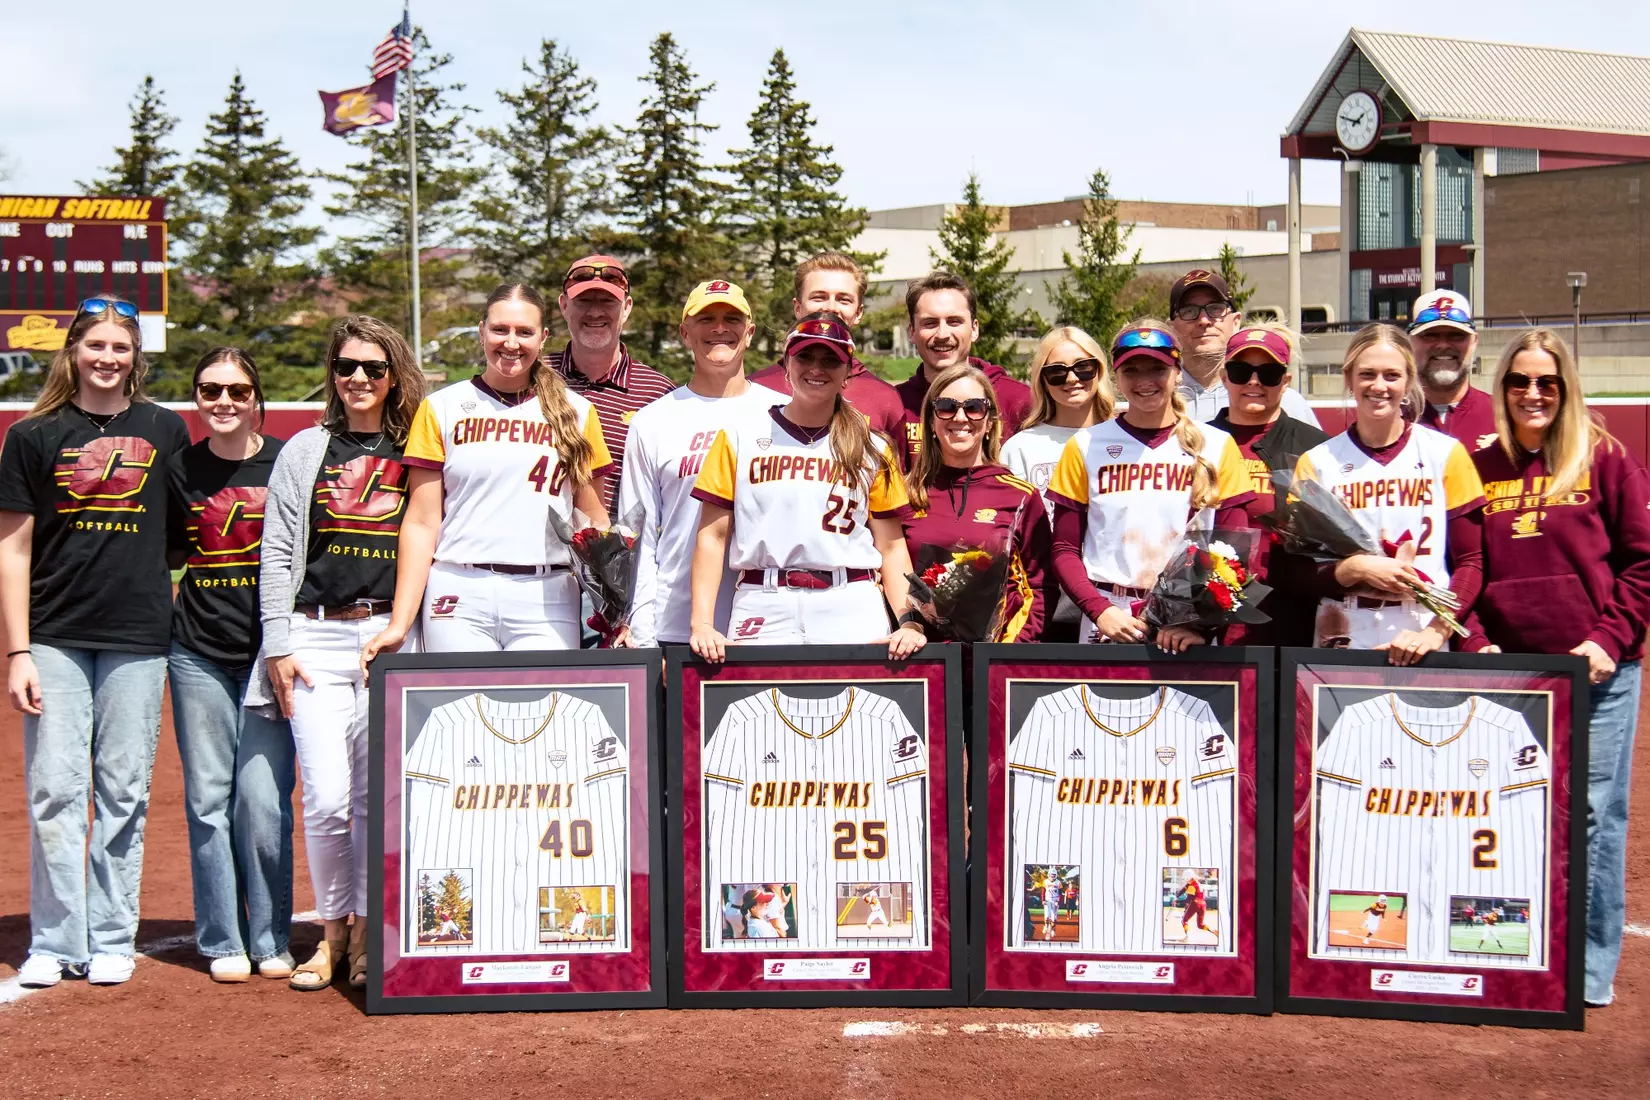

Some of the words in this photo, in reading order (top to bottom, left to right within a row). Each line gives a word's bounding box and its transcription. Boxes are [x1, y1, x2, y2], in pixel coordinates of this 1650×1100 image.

[60, 198, 152, 220] SOFTBALL
[45, 222, 75, 238] OUT
[52, 260, 67, 273] 10
[73, 260, 105, 273] RUNS
[111, 260, 138, 274] HITS
[1379, 274, 1388, 284] THE
[1388, 273, 1407, 284] STUDENT
[1407, 272, 1422, 283] ACTIV
[1435, 271, 1446, 281] NTER
[454, 417, 556, 446] CHIPPEWA
[750, 455, 850, 487] CHIPPEWA
[1098, 462, 1193, 495] CHIPPEWA
[821, 494, 858, 535] 25
[1416, 516, 1433, 556] 2
[195, 577, 257, 588] SOFTBAL
[453, 783, 575, 810] CHIPPEWAS
[749, 780, 875, 810] CHIPPEWAS
[1056, 776, 1183, 808] CHIPPEWAS
[1364, 786, 1493, 818] CHIPPEWAS
[538, 818, 595, 858] 40
[832, 819, 889, 861] 25
[1164, 816, 1190, 858] 6
[1472, 828, 1498, 870] 2
